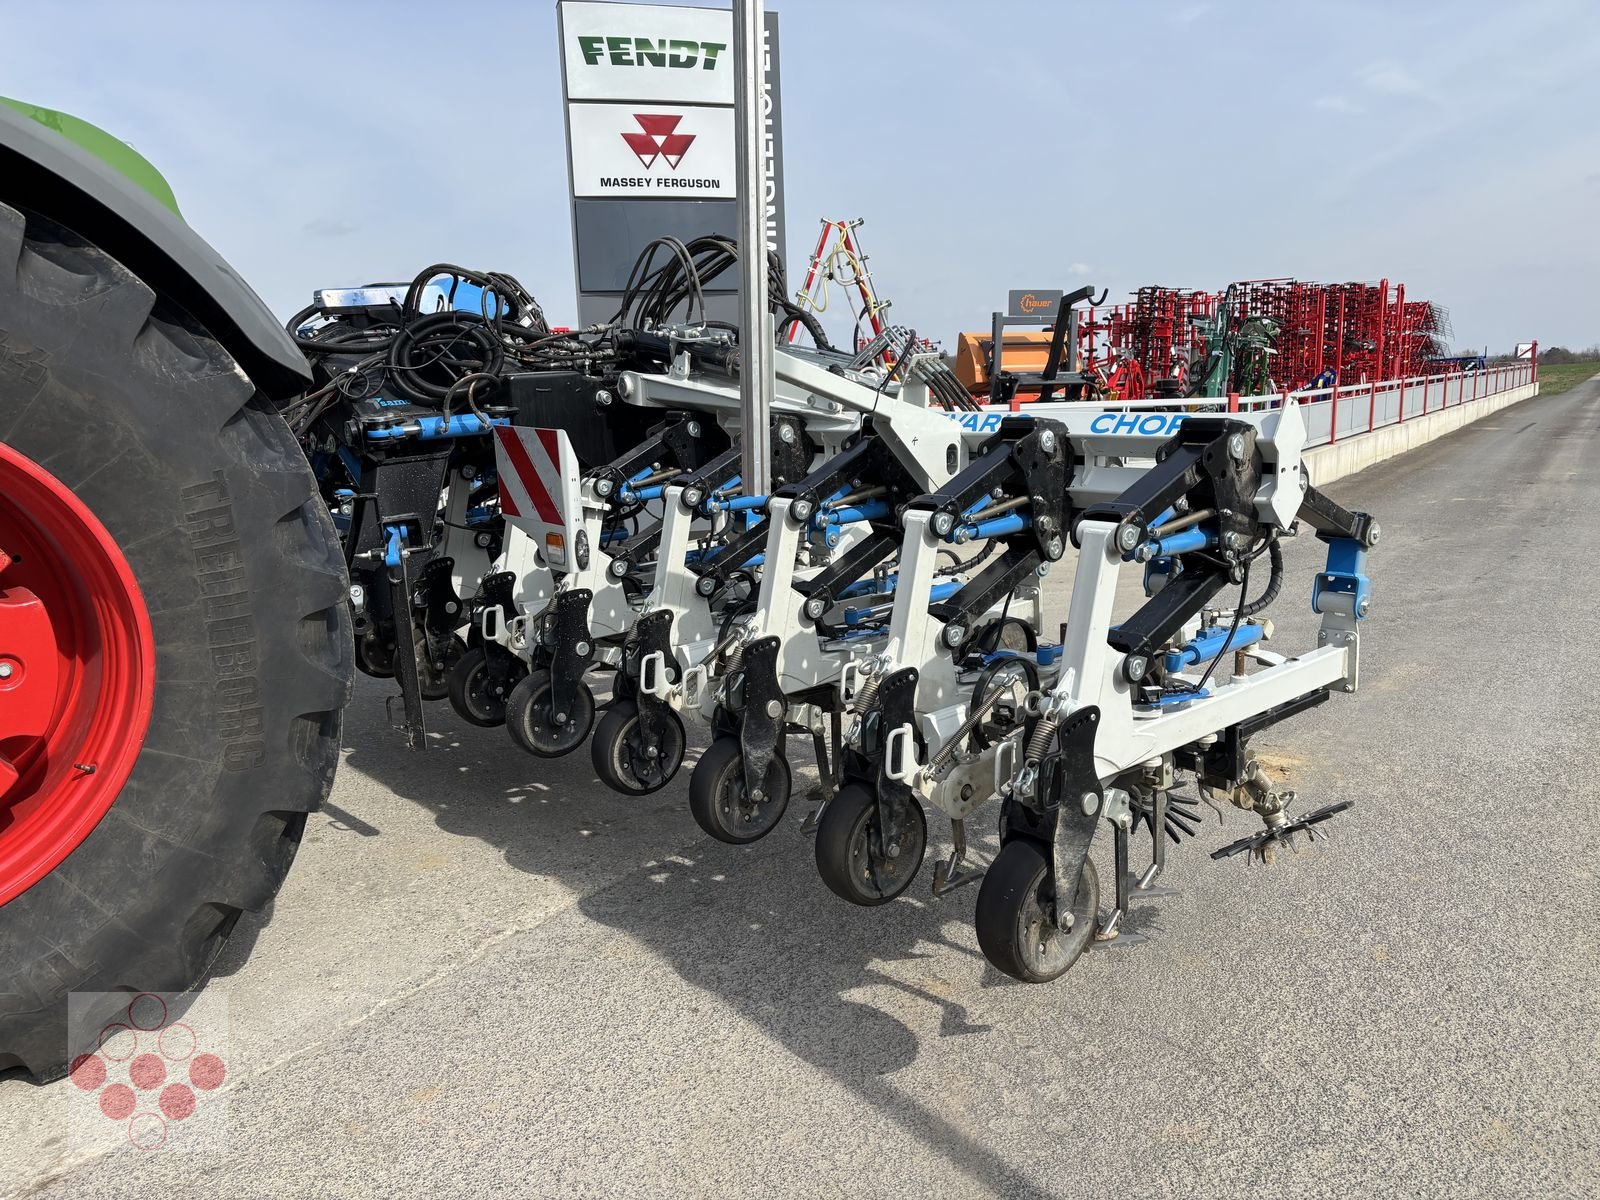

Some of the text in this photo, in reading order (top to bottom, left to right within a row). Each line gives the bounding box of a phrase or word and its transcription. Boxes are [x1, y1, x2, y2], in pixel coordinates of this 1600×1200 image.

[577, 36, 727, 70] FENDT
[600, 177, 720, 189] MASSEY FERGUSON
[180, 469, 267, 772] TRELLEBORG
